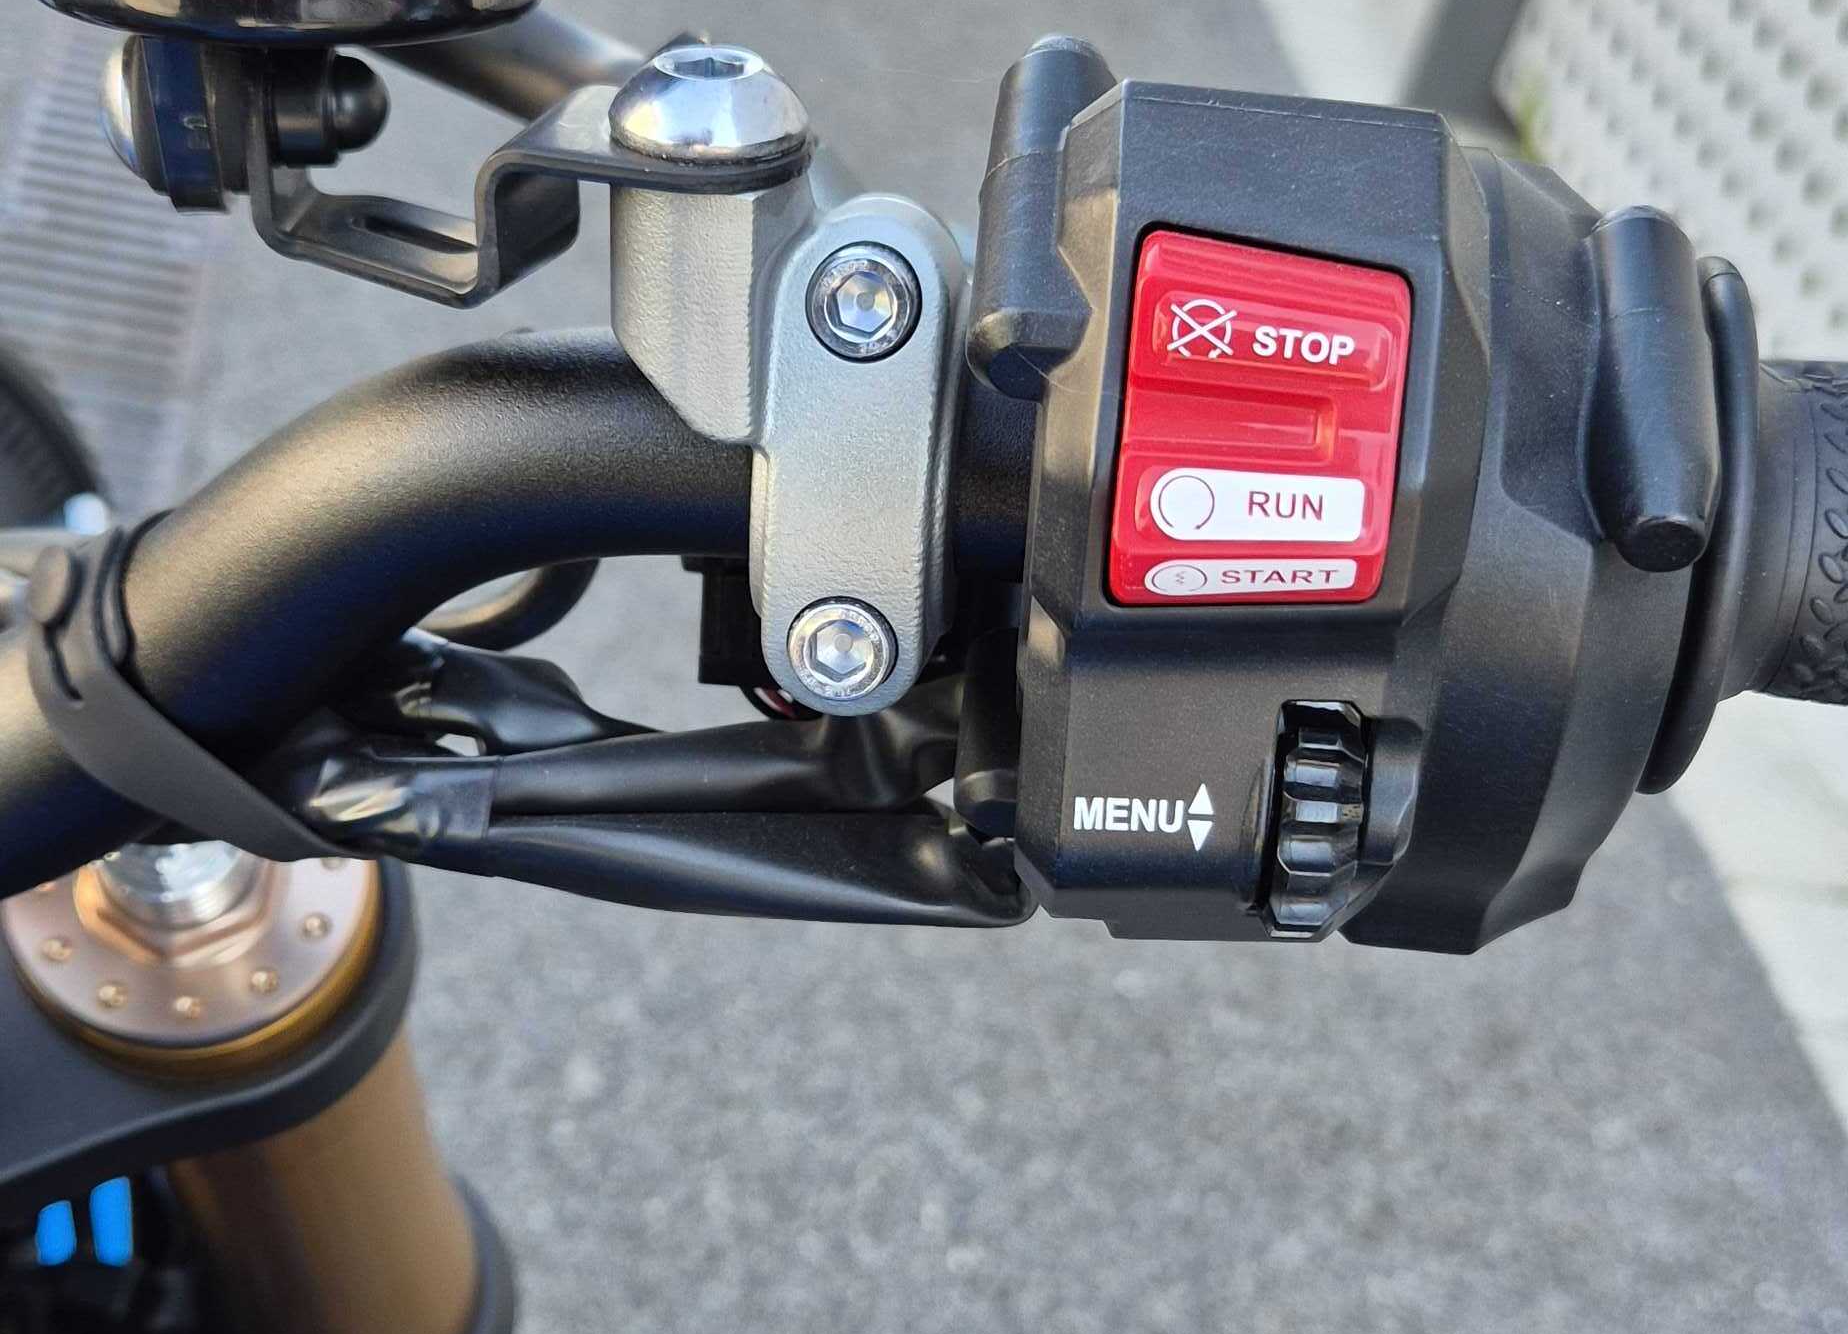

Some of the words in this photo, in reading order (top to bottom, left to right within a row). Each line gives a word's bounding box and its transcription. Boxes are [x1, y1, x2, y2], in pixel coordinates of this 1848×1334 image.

[1252, 325, 1355, 366] STOP
[1248, 490, 1323, 521] RUN
[1220, 569, 1340, 585] START
[1073, 796, 1185, 834] MENU
